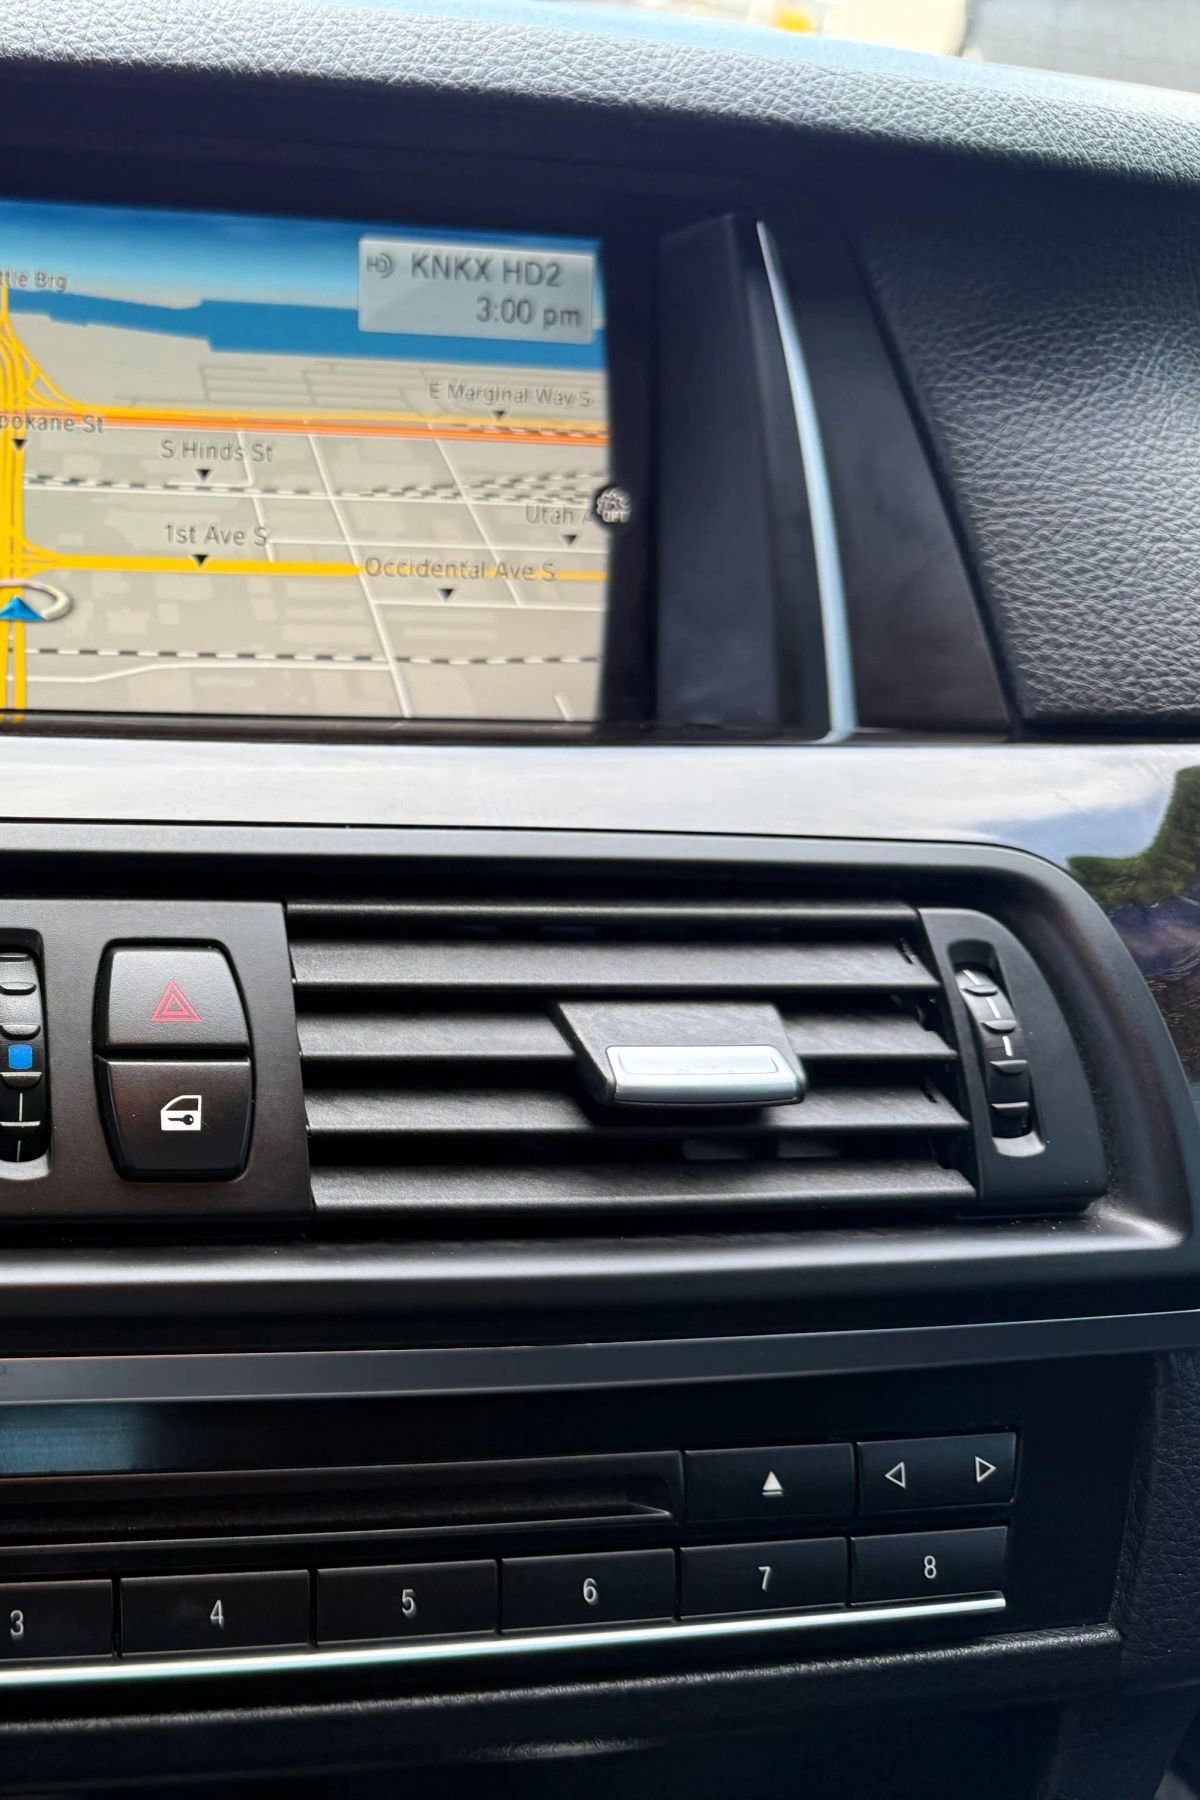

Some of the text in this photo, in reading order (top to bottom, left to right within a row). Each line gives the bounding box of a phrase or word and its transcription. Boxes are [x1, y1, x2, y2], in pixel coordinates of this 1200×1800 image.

[36, 271, 67, 292] Brg
[410, 254, 491, 282] KNKX
[502, 262, 562, 287] HD2
[476, 297, 582, 329] 3:00 pm
[429, 382, 593, 408] E Marginal Way S
[82, 414, 103, 434] St
[161, 440, 273, 462] S Hinds St
[525, 504, 574, 525] Utah
[165, 524, 267, 546] 1st Ave S
[365, 557, 557, 582] Occidental Ave S
[758, 1566, 772, 1591] 7
[923, 1556, 937, 1580] 8
[401, 1589, 416, 1617] 5
[582, 1578, 598, 1604] 6
[9, 1609, 24, 1639] 3
[208, 1598, 224, 1628] 4
